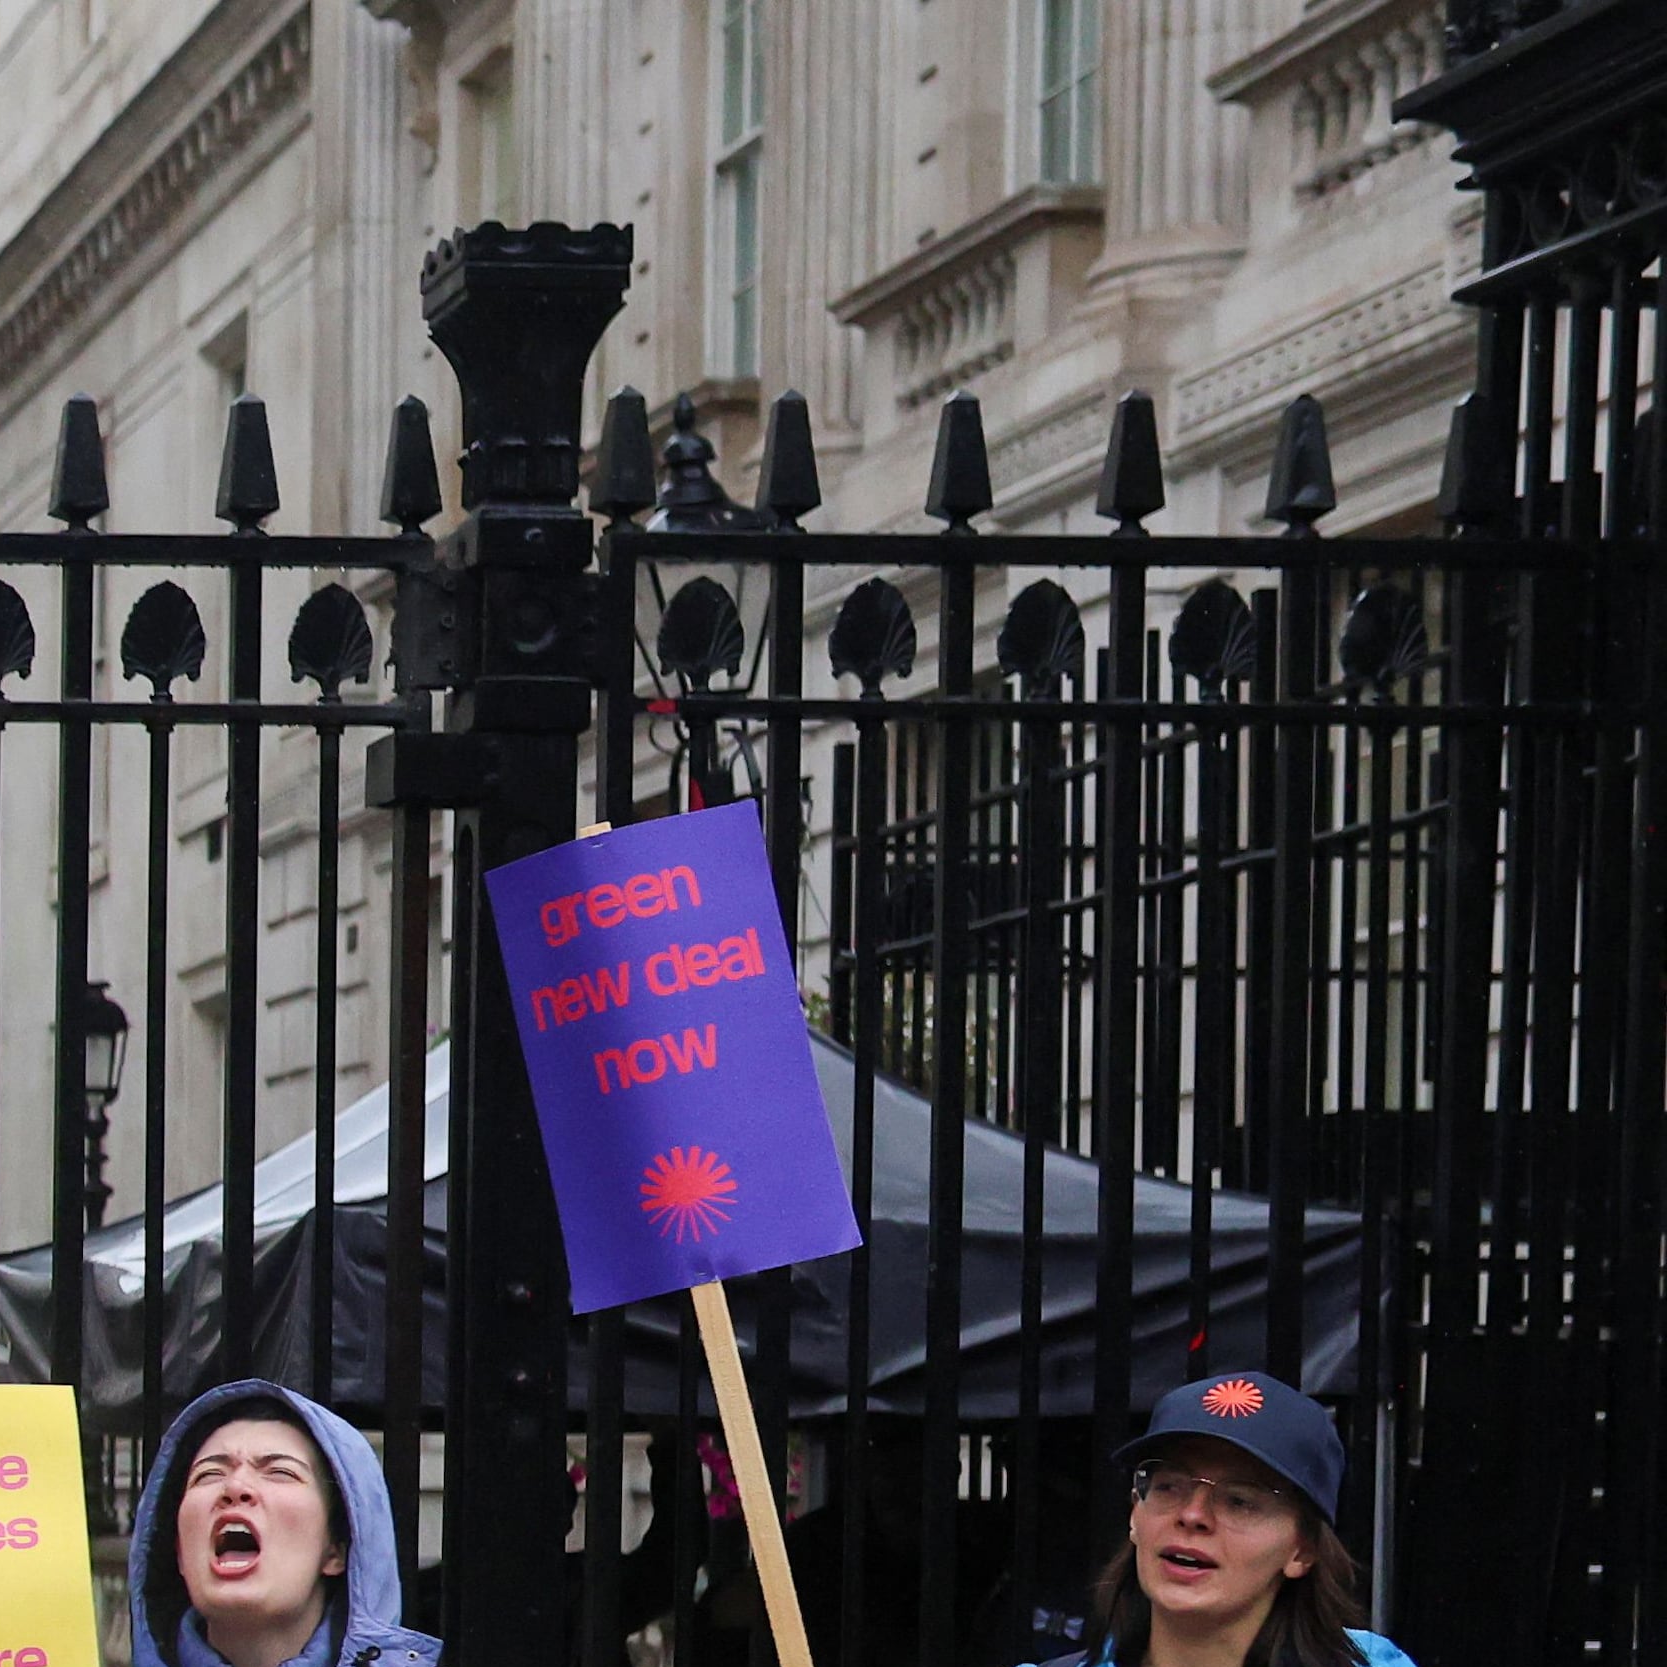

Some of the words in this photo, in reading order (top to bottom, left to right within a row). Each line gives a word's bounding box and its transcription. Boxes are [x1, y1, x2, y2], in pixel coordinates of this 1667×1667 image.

[540, 865, 702, 948] green
[531, 961, 630, 1031] new
[644, 927, 766, 996] deal
[593, 1024, 717, 1095] now
